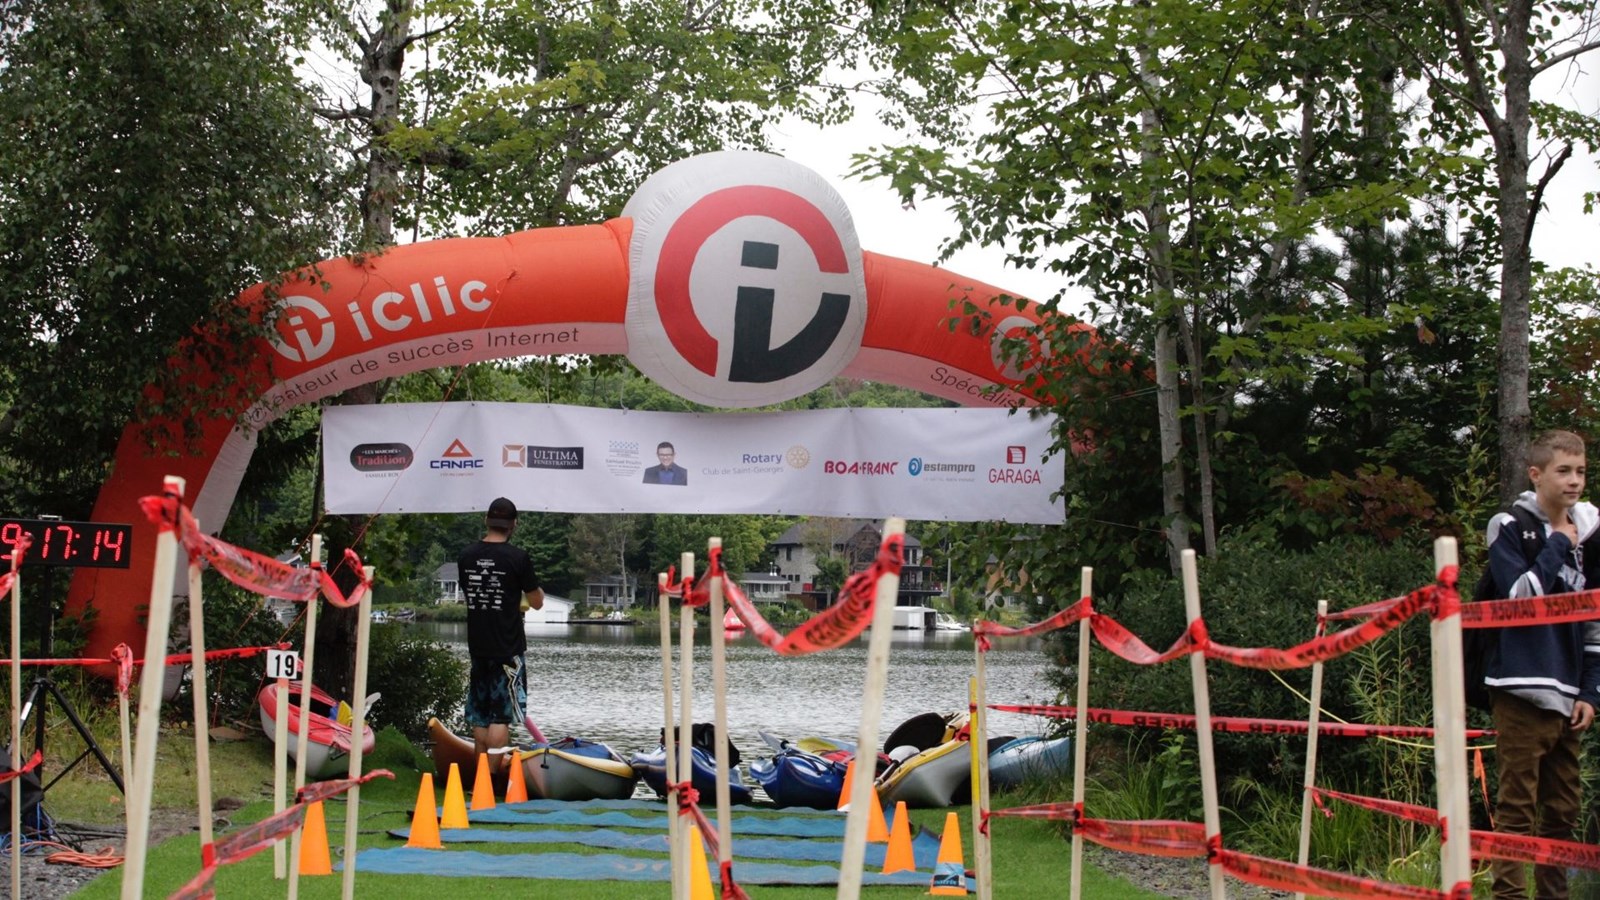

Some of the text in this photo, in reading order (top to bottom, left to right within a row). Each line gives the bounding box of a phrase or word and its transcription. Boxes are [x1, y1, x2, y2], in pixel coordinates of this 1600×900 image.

[347, 275, 492, 342] iclic
[350, 355, 380, 377] de
[387, 334, 475, 365] succès
[487, 327, 580, 348] Internet
[357, 454, 406, 467] Tradition
[533, 450, 578, 461] ULTIMA
[742, 453, 783, 465] Rotary
[430, 459, 484, 469] CANAC
[533, 459, 579, 467] FENESTRATION
[923, 463, 976, 474] estampro
[702, 465, 784, 476] Club de Saint-Georges
[988, 468, 1042, 484] GARAGA
[274, 653, 295, 677] 19
